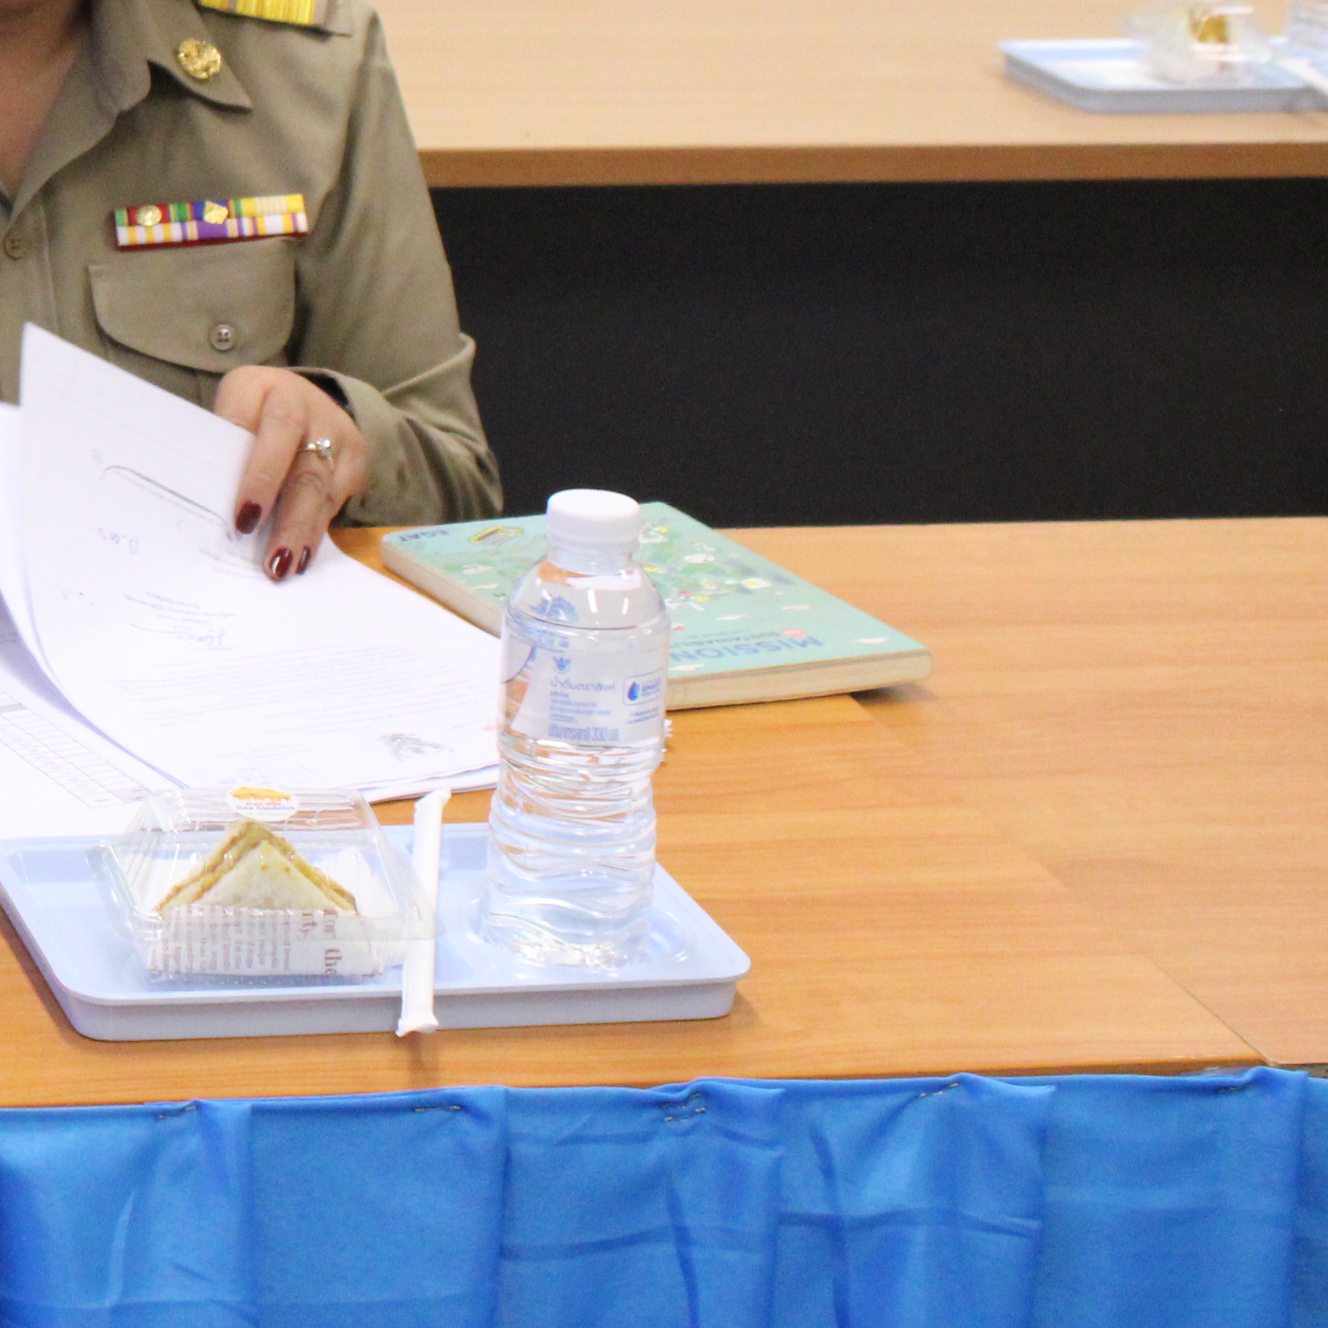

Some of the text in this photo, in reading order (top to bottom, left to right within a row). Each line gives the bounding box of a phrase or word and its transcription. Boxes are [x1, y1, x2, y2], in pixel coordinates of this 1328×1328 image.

[670, 635, 825, 662] MISSION
[591, 727, 608, 742] 330
[324, 948, 343, 976] the
